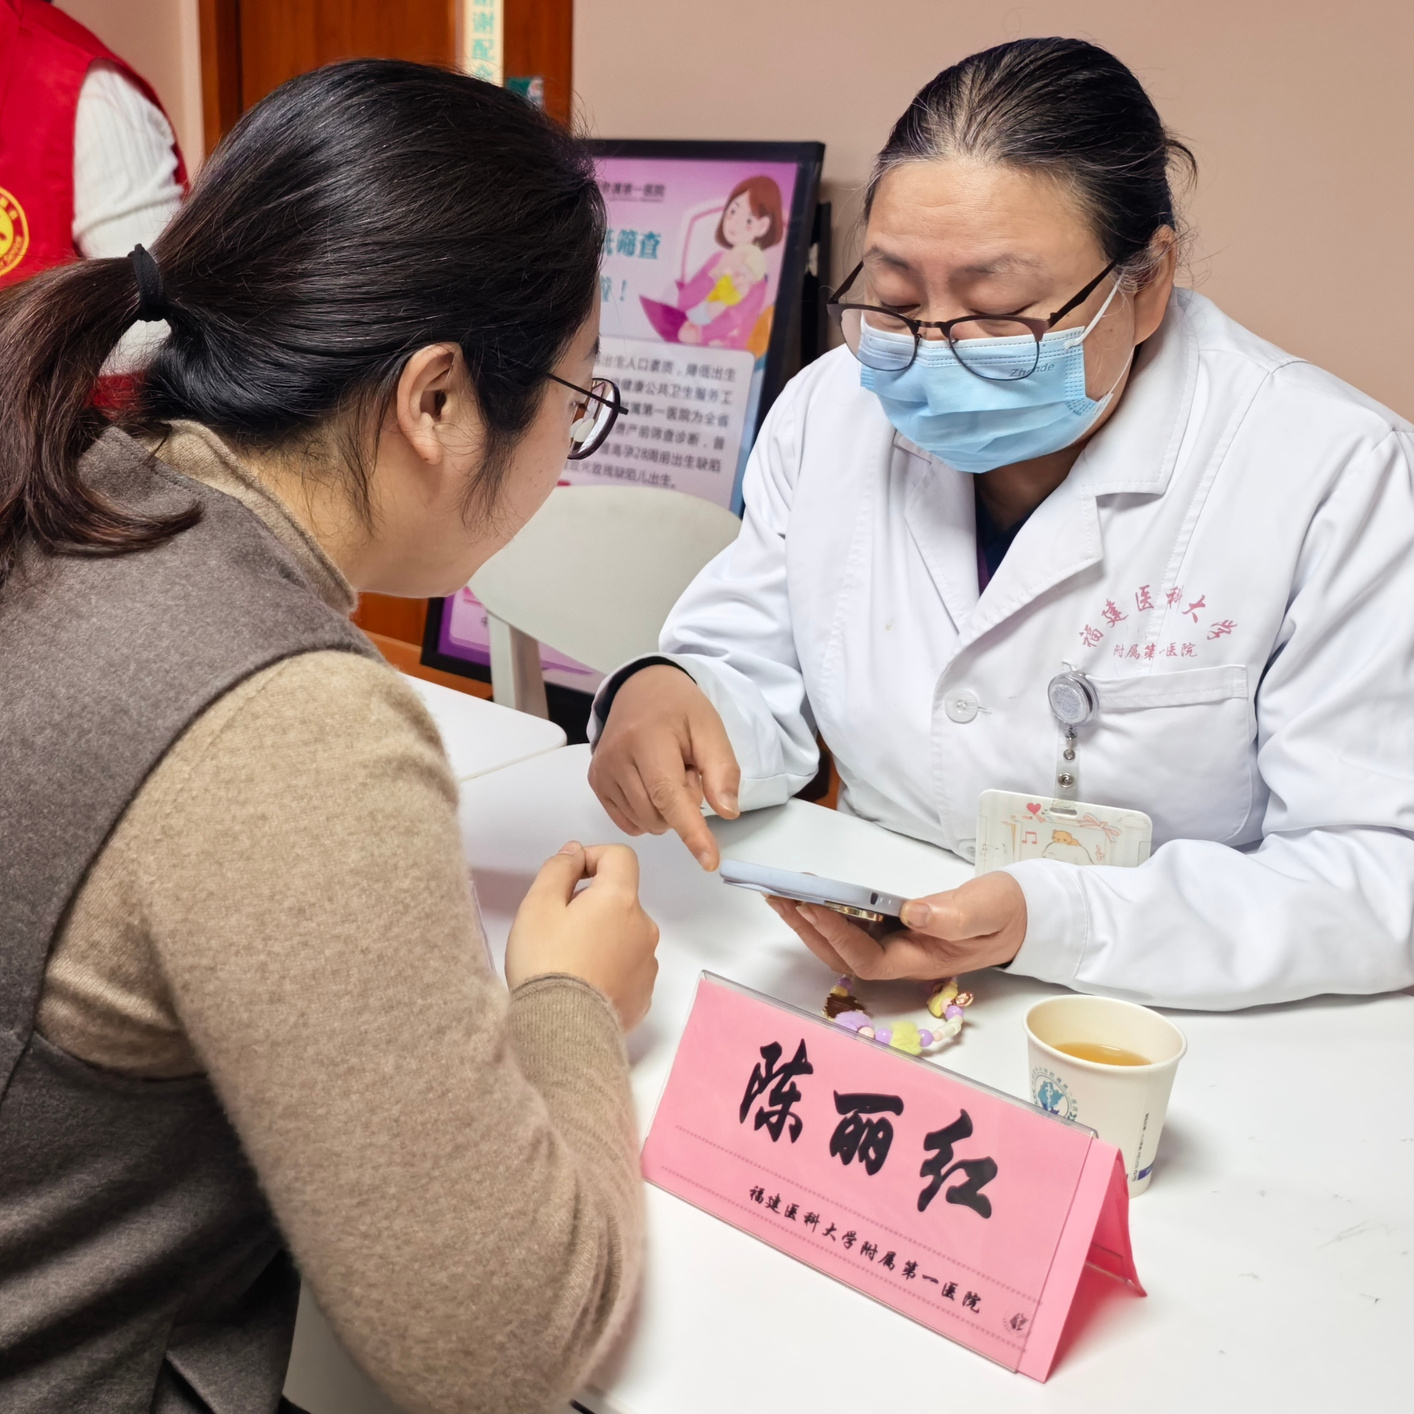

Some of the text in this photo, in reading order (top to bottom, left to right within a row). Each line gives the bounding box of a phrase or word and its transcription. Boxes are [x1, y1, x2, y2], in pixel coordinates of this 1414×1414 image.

[1079, 584, 1238, 648] 福建医科大学
[1112, 642, 1198, 661] 附属第一医院
[738, 1038, 999, 1219] 陈丽红
[748, 1184, 982, 1315] 福建医科大学附属第一医院
